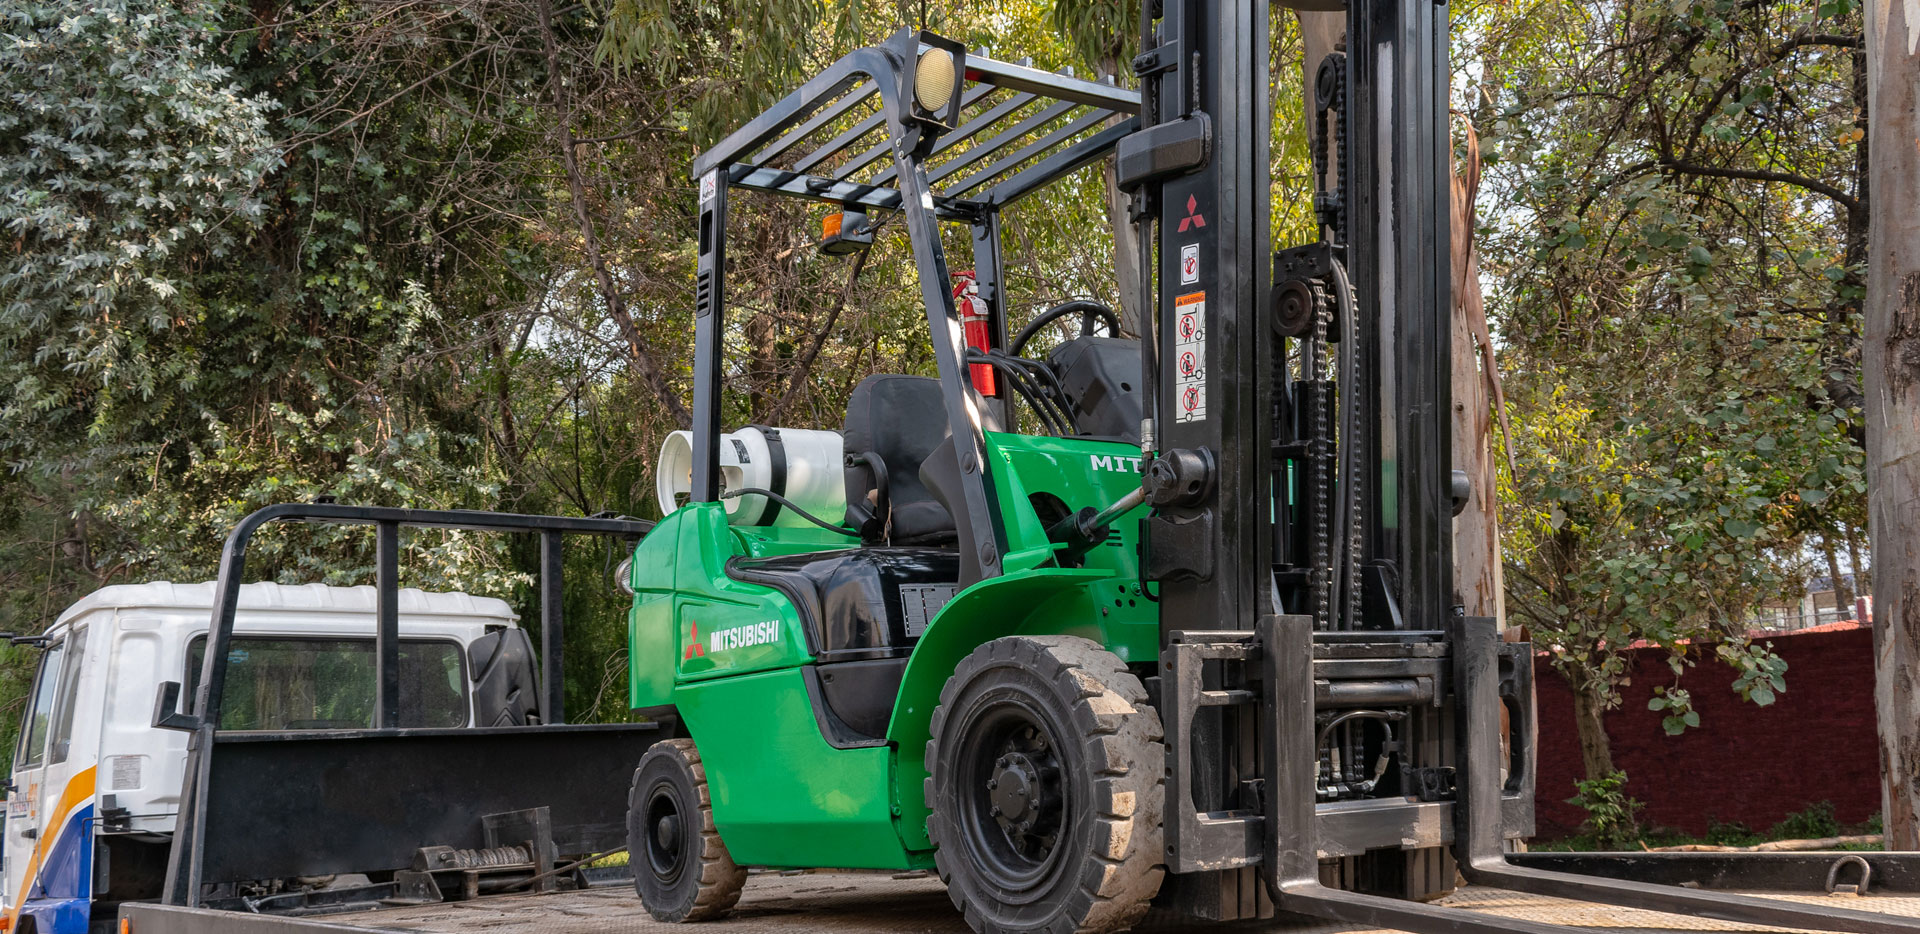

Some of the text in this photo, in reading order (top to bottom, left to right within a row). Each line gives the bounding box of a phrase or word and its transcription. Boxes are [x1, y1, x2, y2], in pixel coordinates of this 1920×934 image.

[1183, 294, 1205, 304] WARNING
[1090, 454, 1142, 473] MIT
[710, 619, 779, 653] MITSUBISHI
